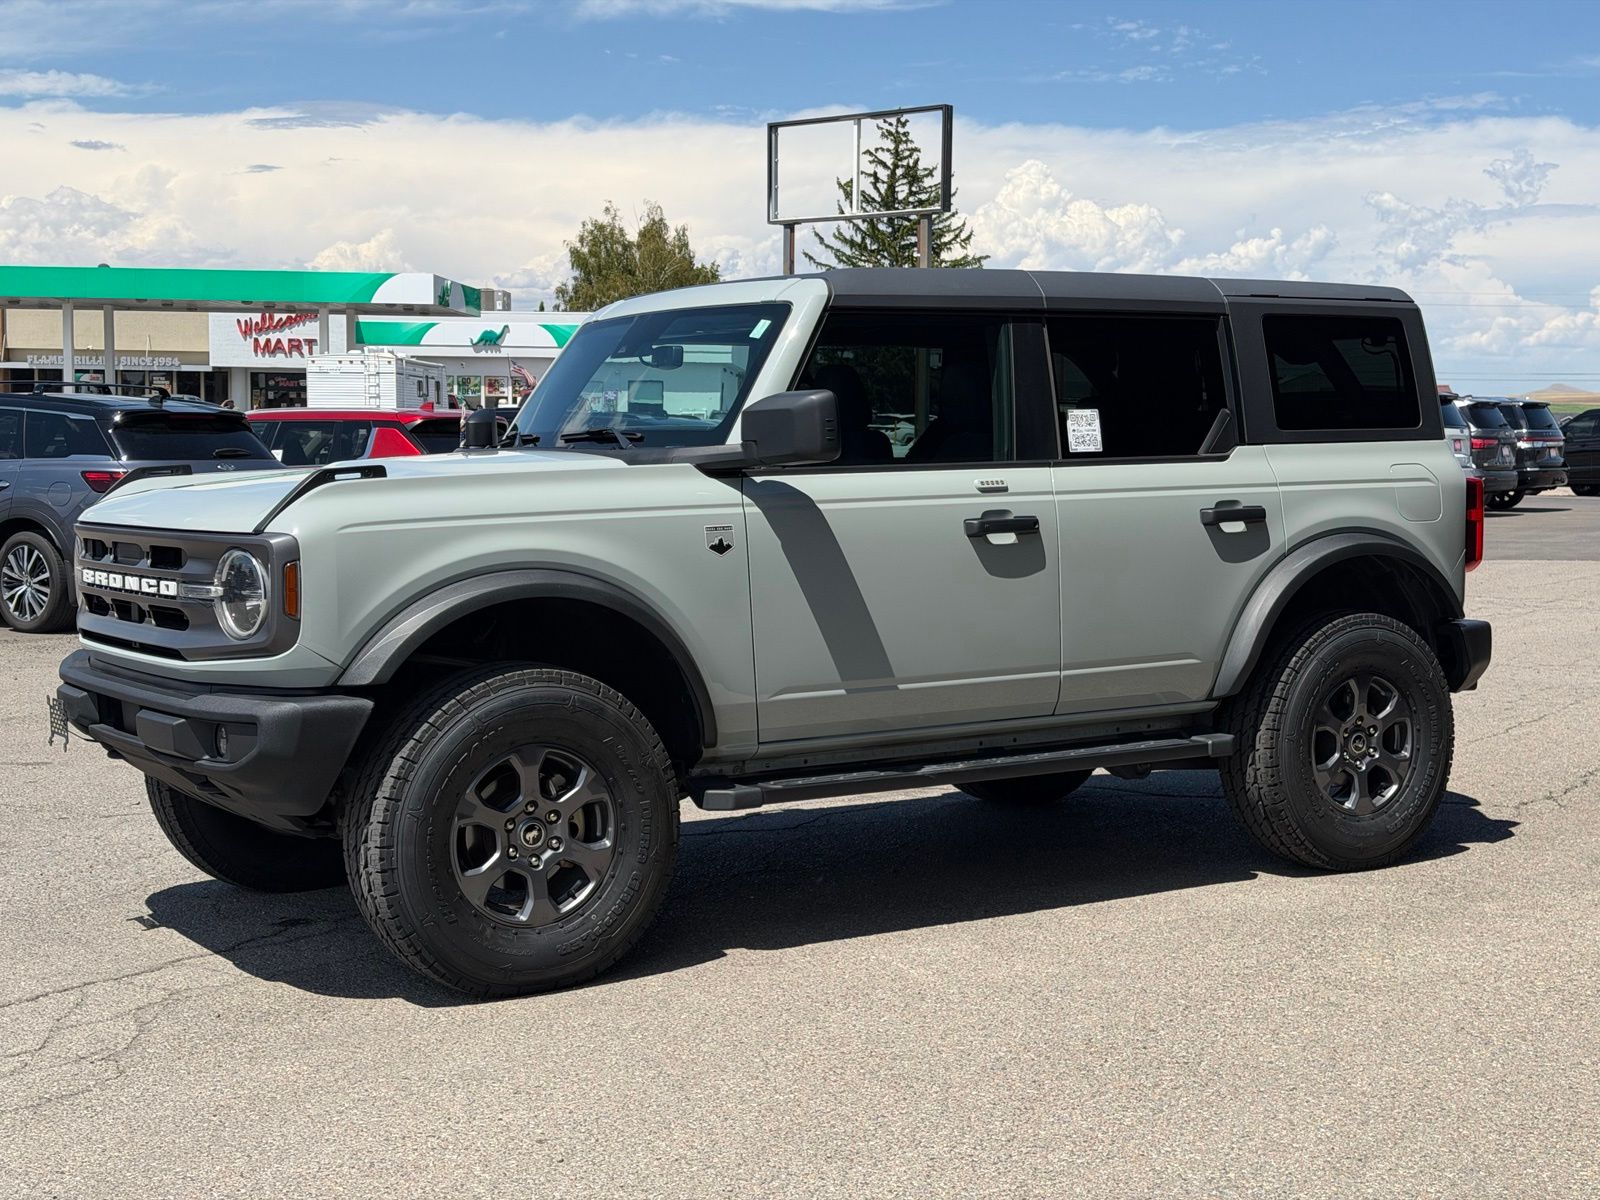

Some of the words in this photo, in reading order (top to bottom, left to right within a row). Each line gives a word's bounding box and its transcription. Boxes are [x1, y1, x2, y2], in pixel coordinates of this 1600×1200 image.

[253, 337, 318, 357] MART
[27, 355, 64, 365] FLAME
[120, 356, 153, 366] SINCE
[153, 356, 181, 367] 1954
[461, 377, 471, 385] GO
[82, 569, 178, 596] BRONCO
